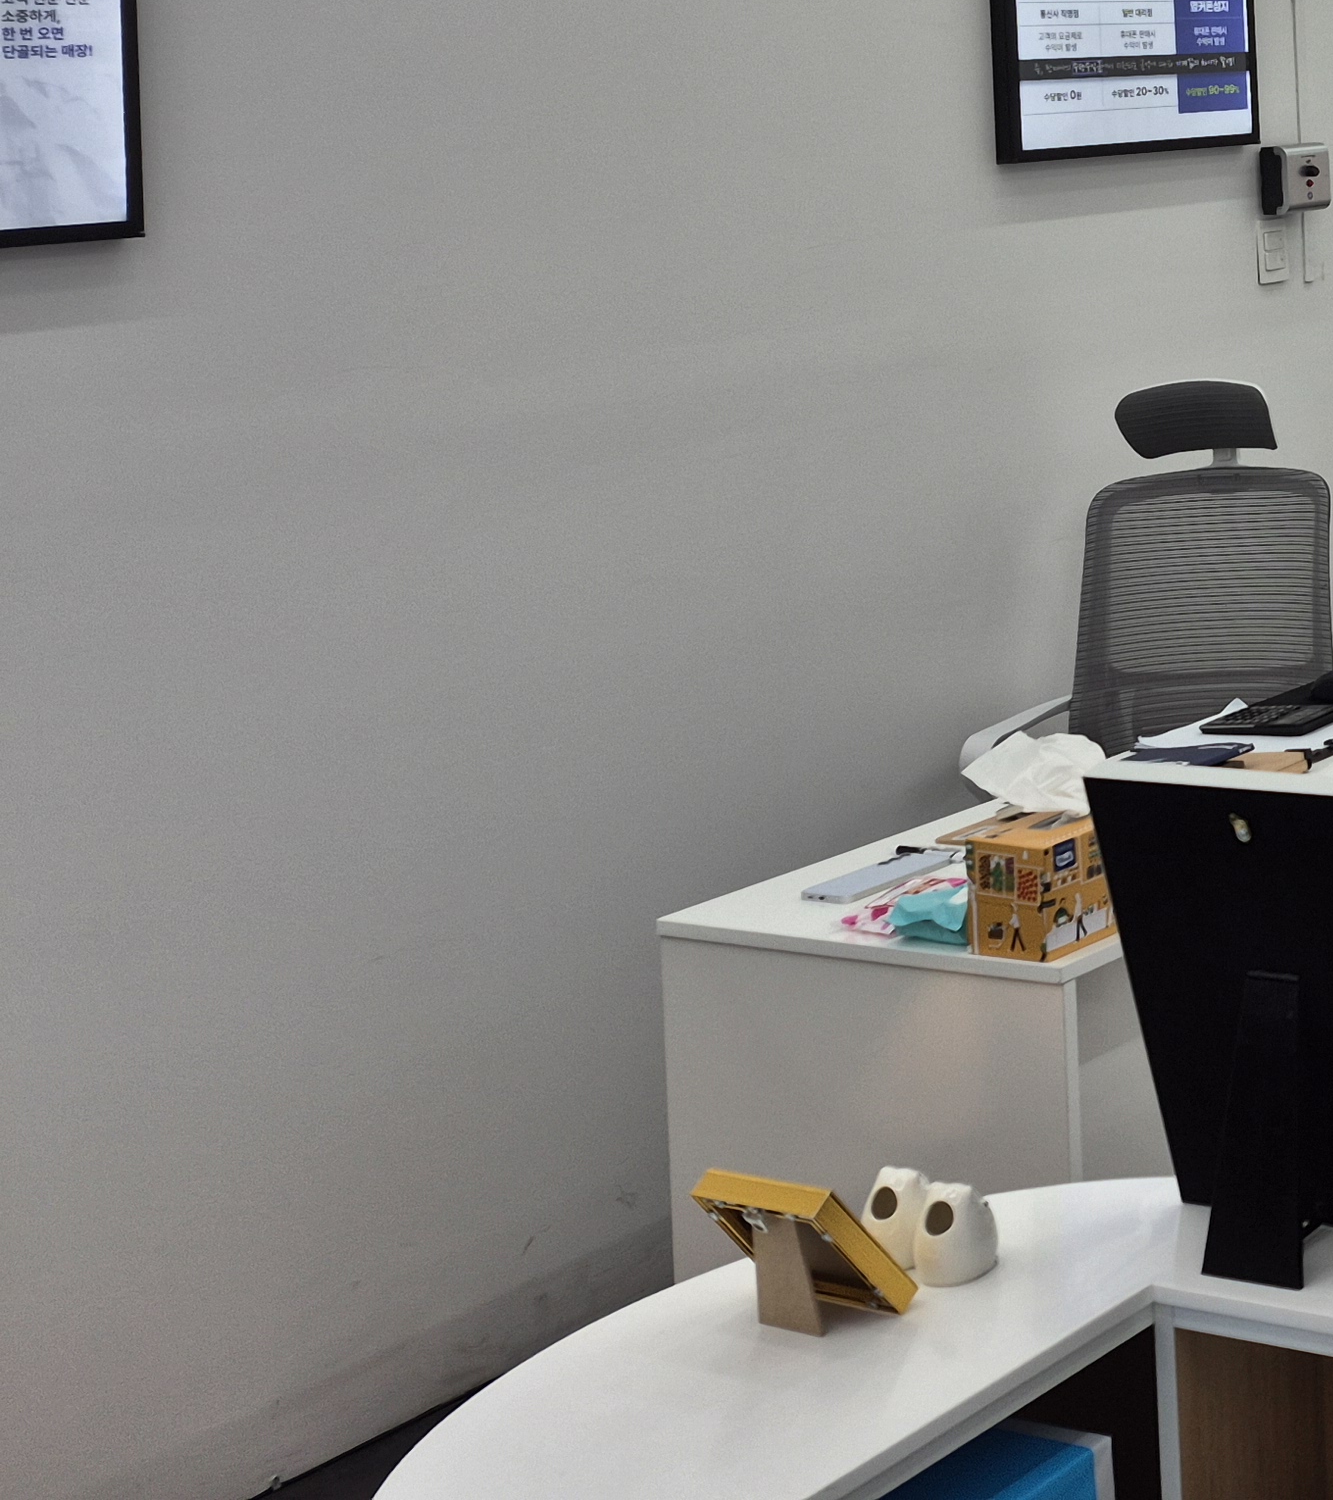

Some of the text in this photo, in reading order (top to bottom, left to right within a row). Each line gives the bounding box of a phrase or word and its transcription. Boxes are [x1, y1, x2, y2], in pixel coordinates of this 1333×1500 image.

[1, 9, 60, 24] 소중하게,
[1, 26, 64, 41] 한 번 오면
[2, 44, 93, 59] 단골되는 매장!
